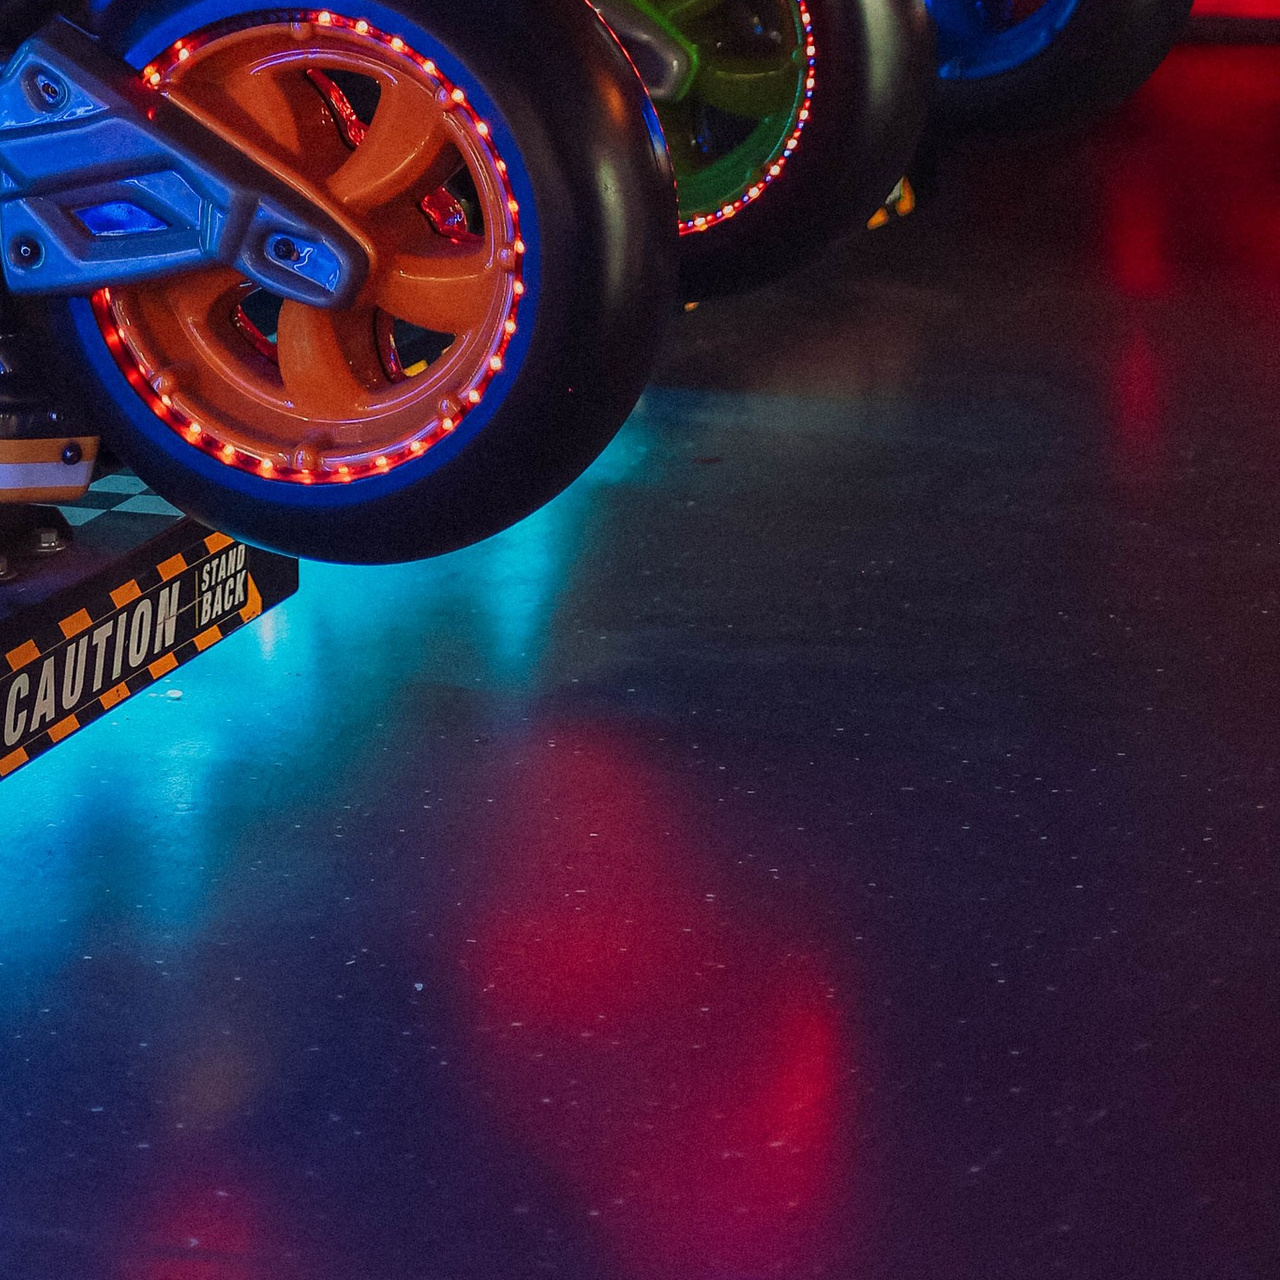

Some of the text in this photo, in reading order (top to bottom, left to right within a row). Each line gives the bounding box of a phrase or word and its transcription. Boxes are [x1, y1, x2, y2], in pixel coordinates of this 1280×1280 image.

[200, 543, 247, 592] STAND
[200, 572, 246, 626] BACK
[3, 580, 182, 748] CAUTION
